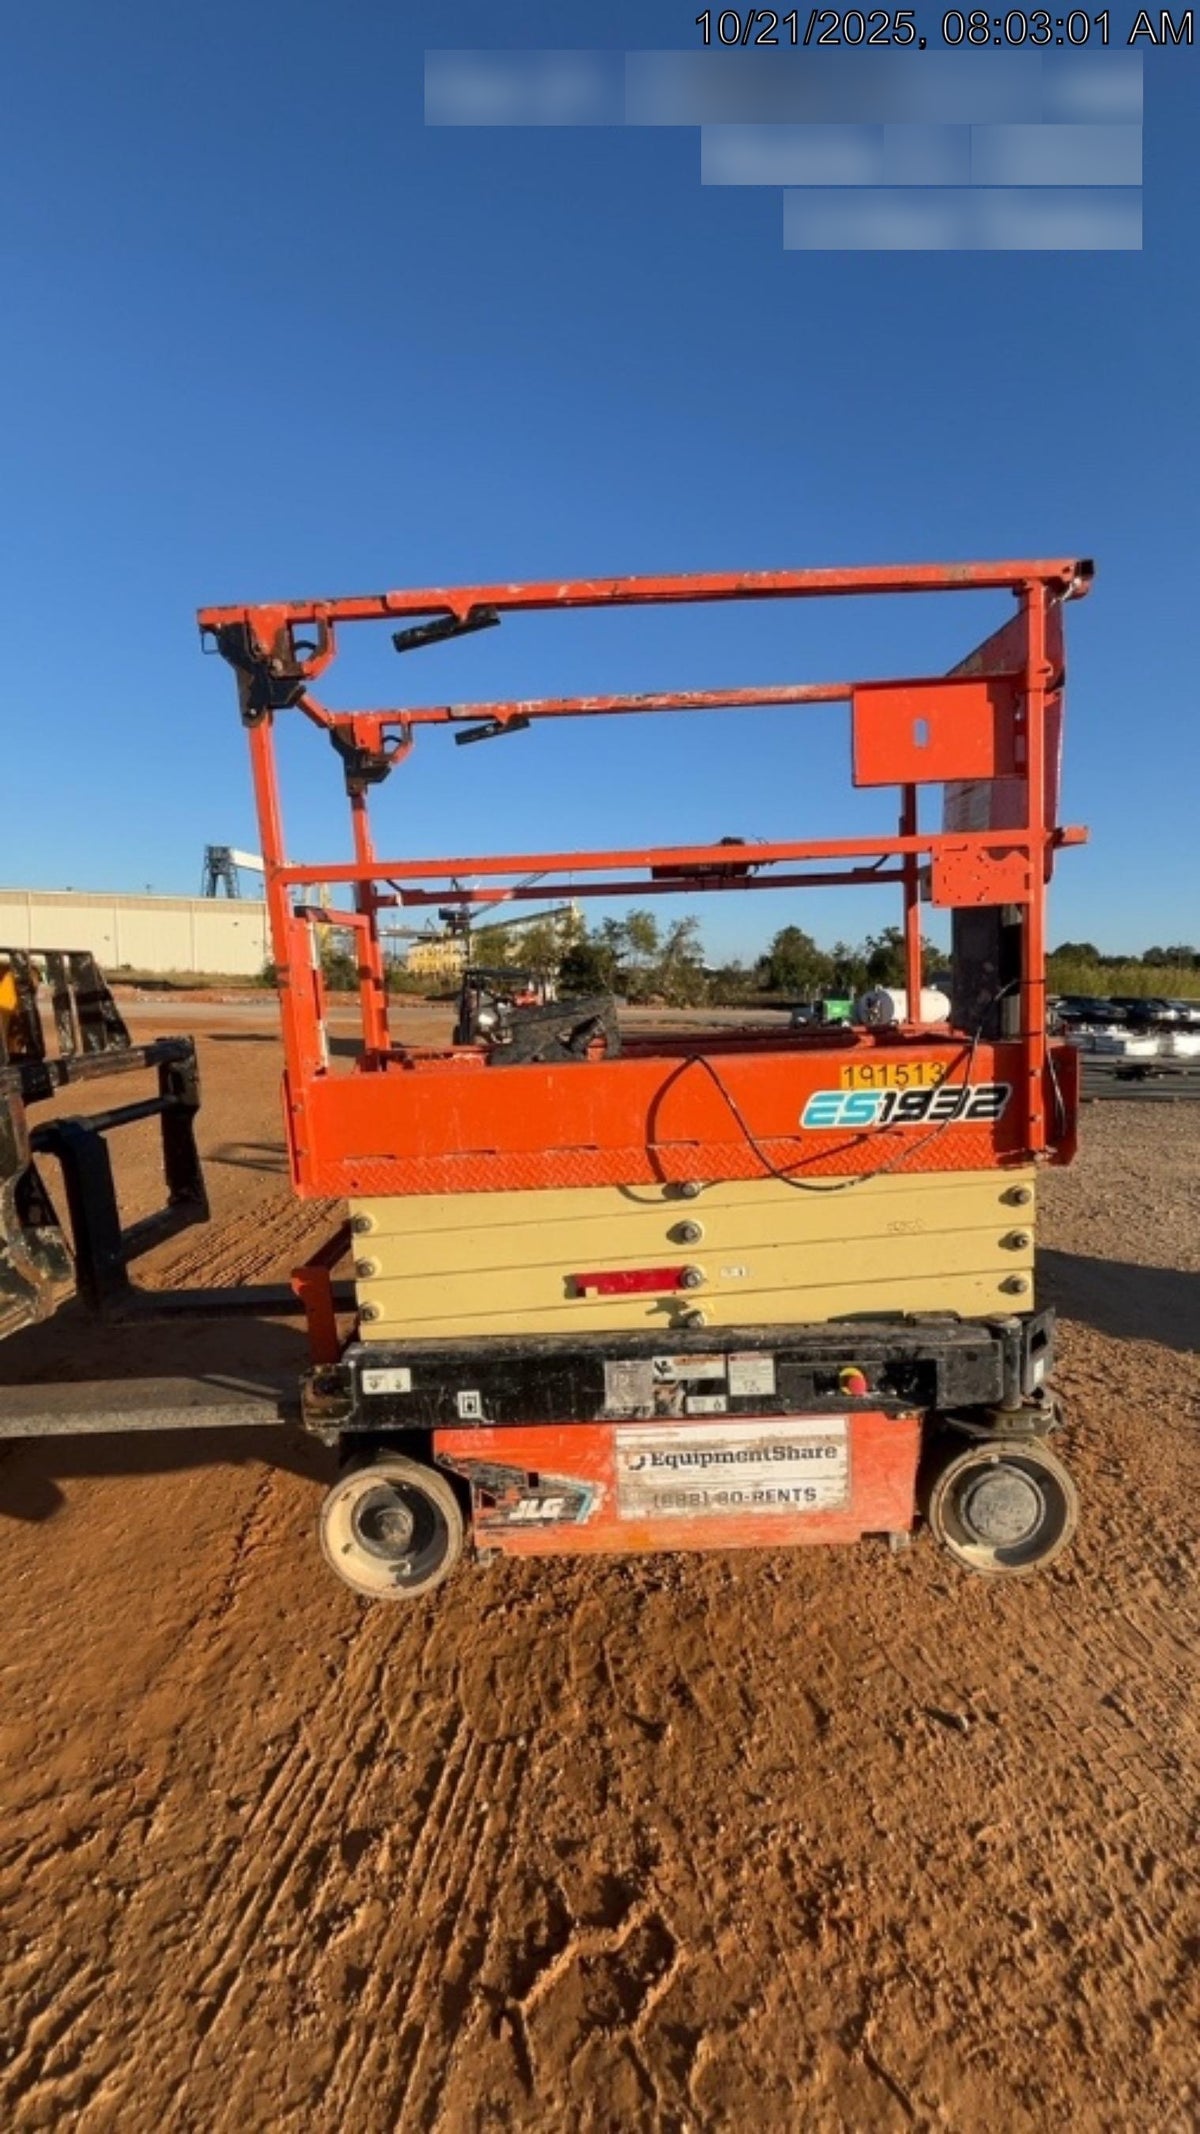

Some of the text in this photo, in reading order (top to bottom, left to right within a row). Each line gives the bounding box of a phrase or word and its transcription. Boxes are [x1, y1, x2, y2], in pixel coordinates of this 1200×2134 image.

[843, 1063, 945, 1088] 191513
[803, 1086, 1009, 1127] ES1932
[651, 1445, 838, 1469] EquipmentShare
[508, 1498, 565, 1520] JLG
